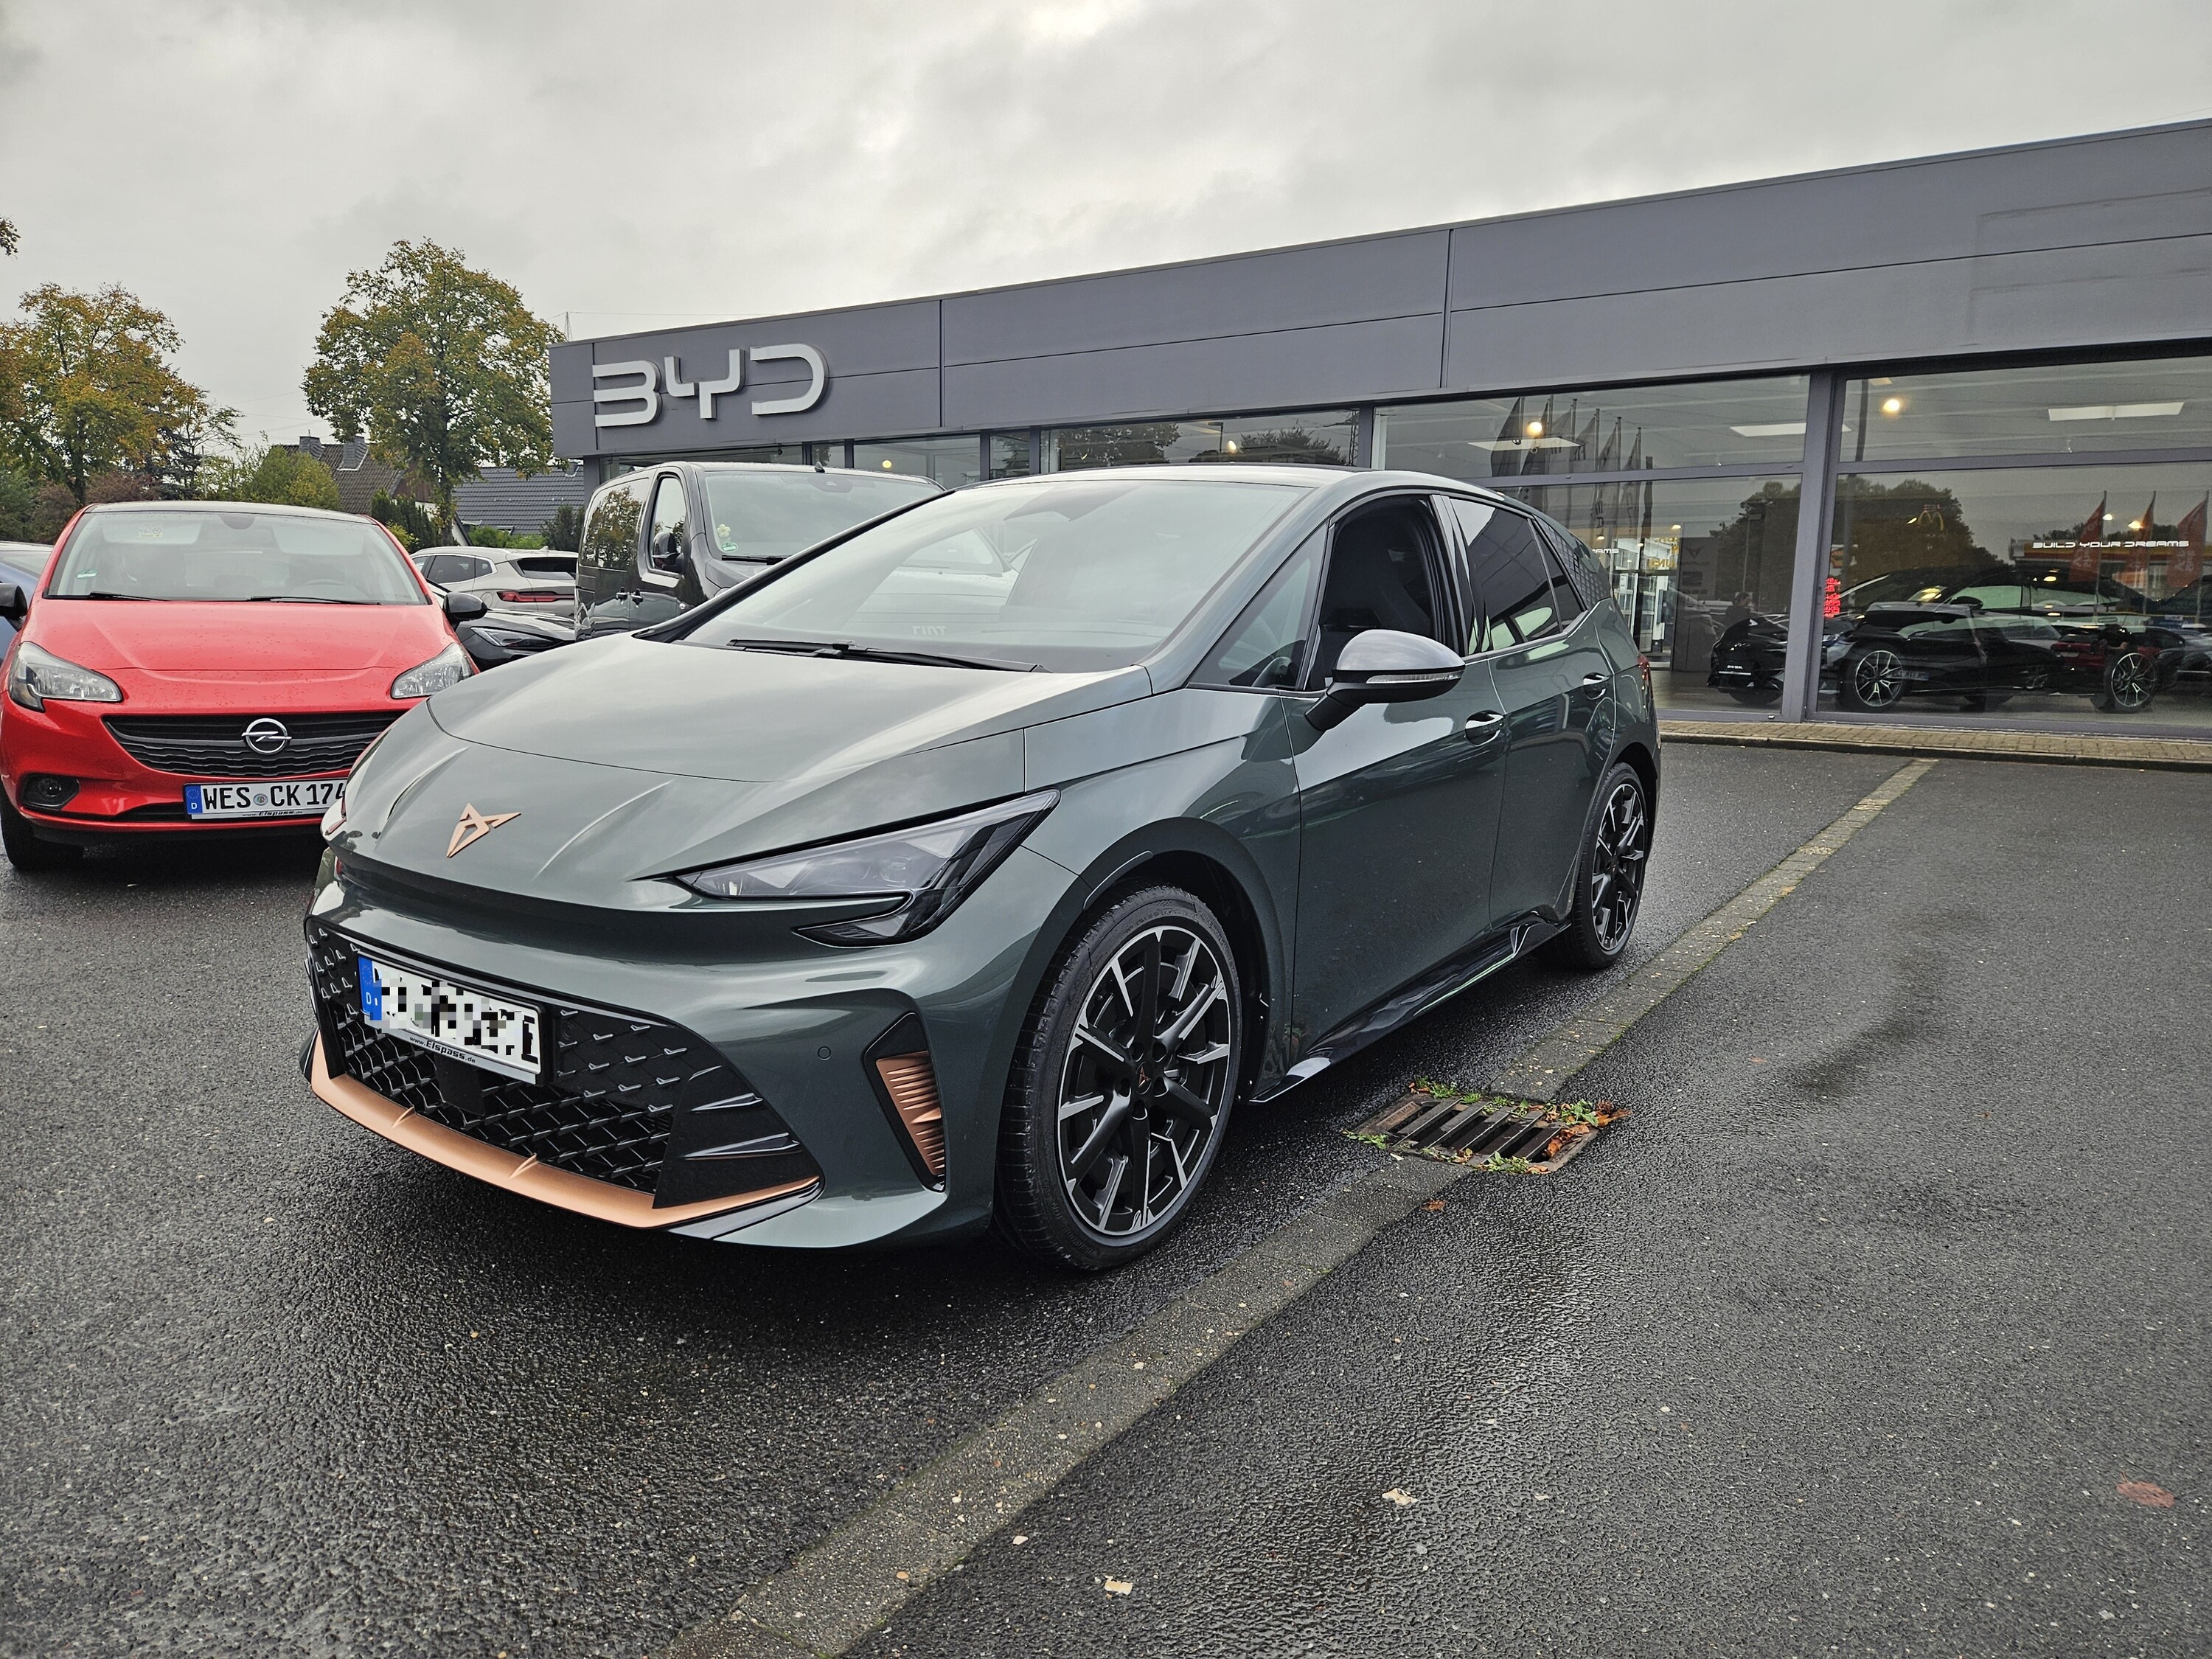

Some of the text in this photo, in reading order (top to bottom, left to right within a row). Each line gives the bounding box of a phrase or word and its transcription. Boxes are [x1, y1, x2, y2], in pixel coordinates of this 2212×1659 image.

[592, 344, 827, 428] BYD
[203, 787, 251, 809] WES
[270, 785, 301, 807] CK
[366, 992, 372, 1005] D
[409, 1036, 476, 1063] www.Elspass.de
